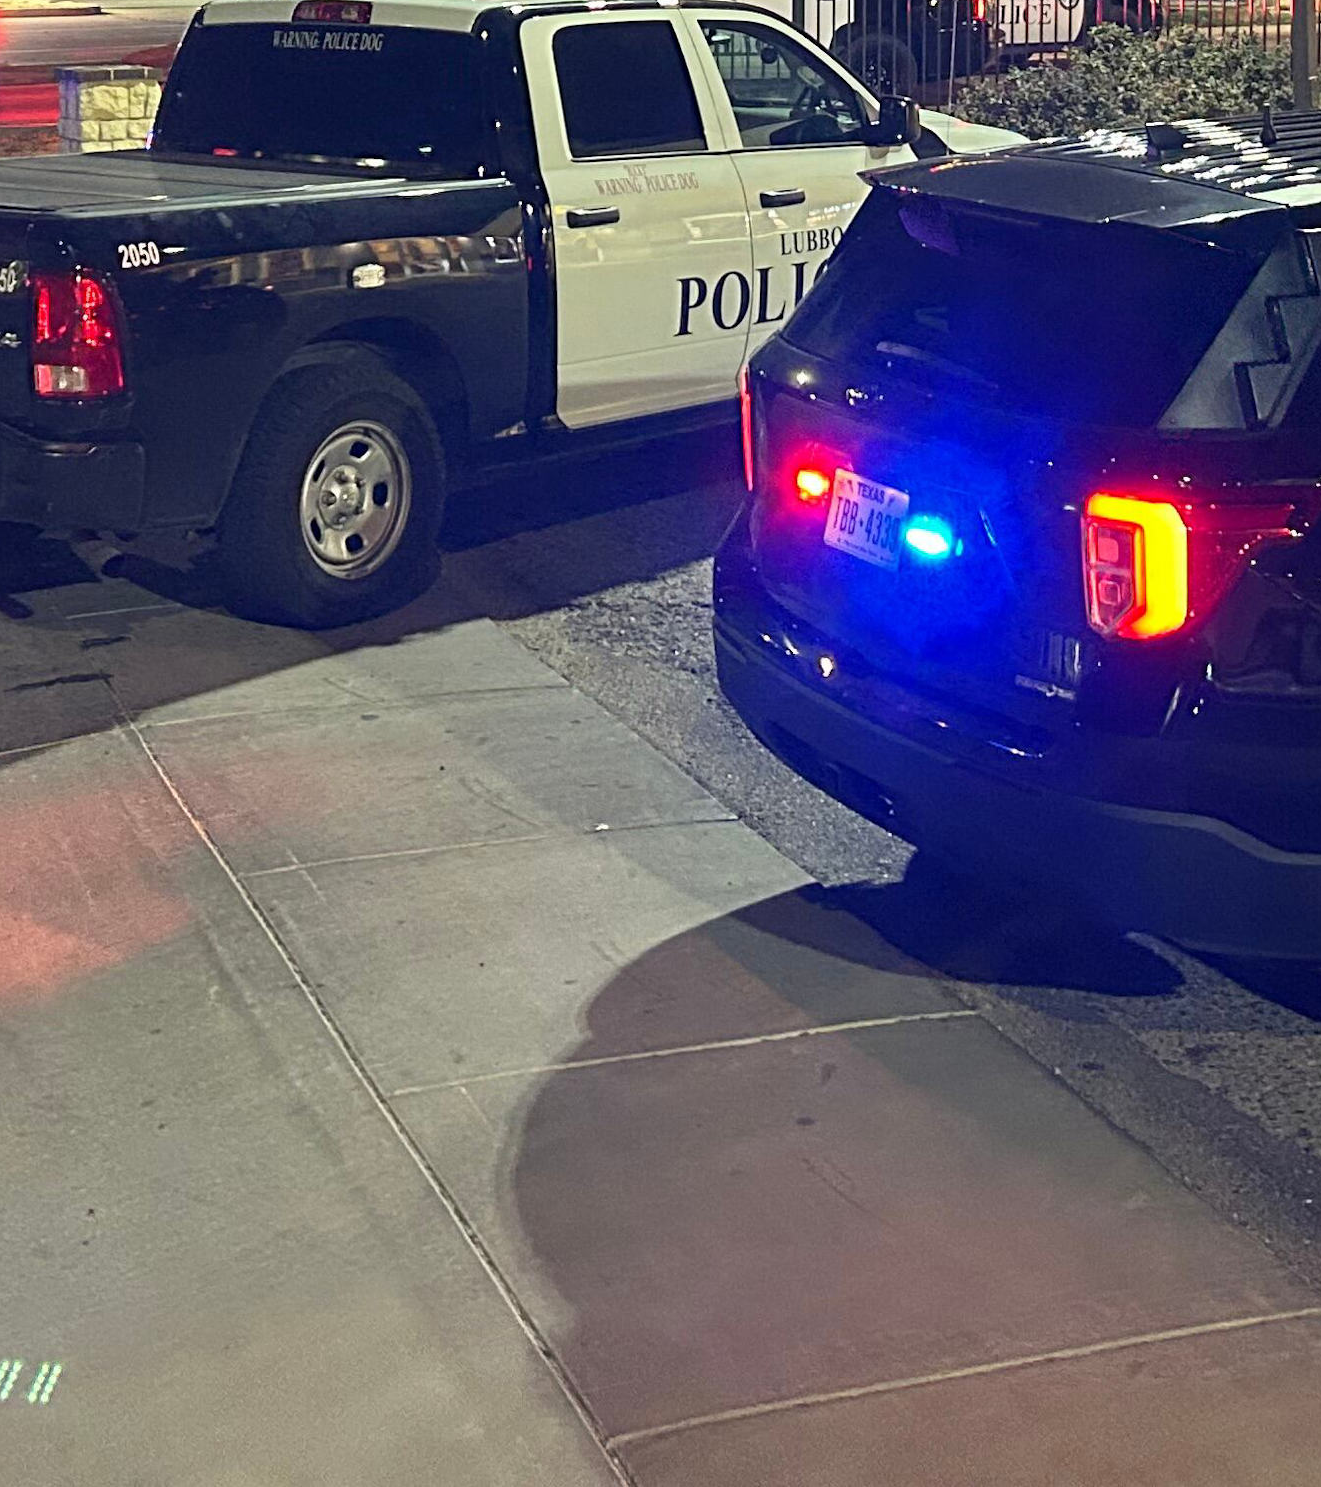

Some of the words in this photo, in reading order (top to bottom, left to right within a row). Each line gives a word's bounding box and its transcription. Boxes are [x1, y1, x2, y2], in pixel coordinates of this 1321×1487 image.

[323, 32, 359, 50] POLICE
[360, 33, 384, 51] DOG
[678, 172, 699, 189] DOG
[118, 241, 160, 269] 2050
[858, 481, 885, 505] TEXAS
